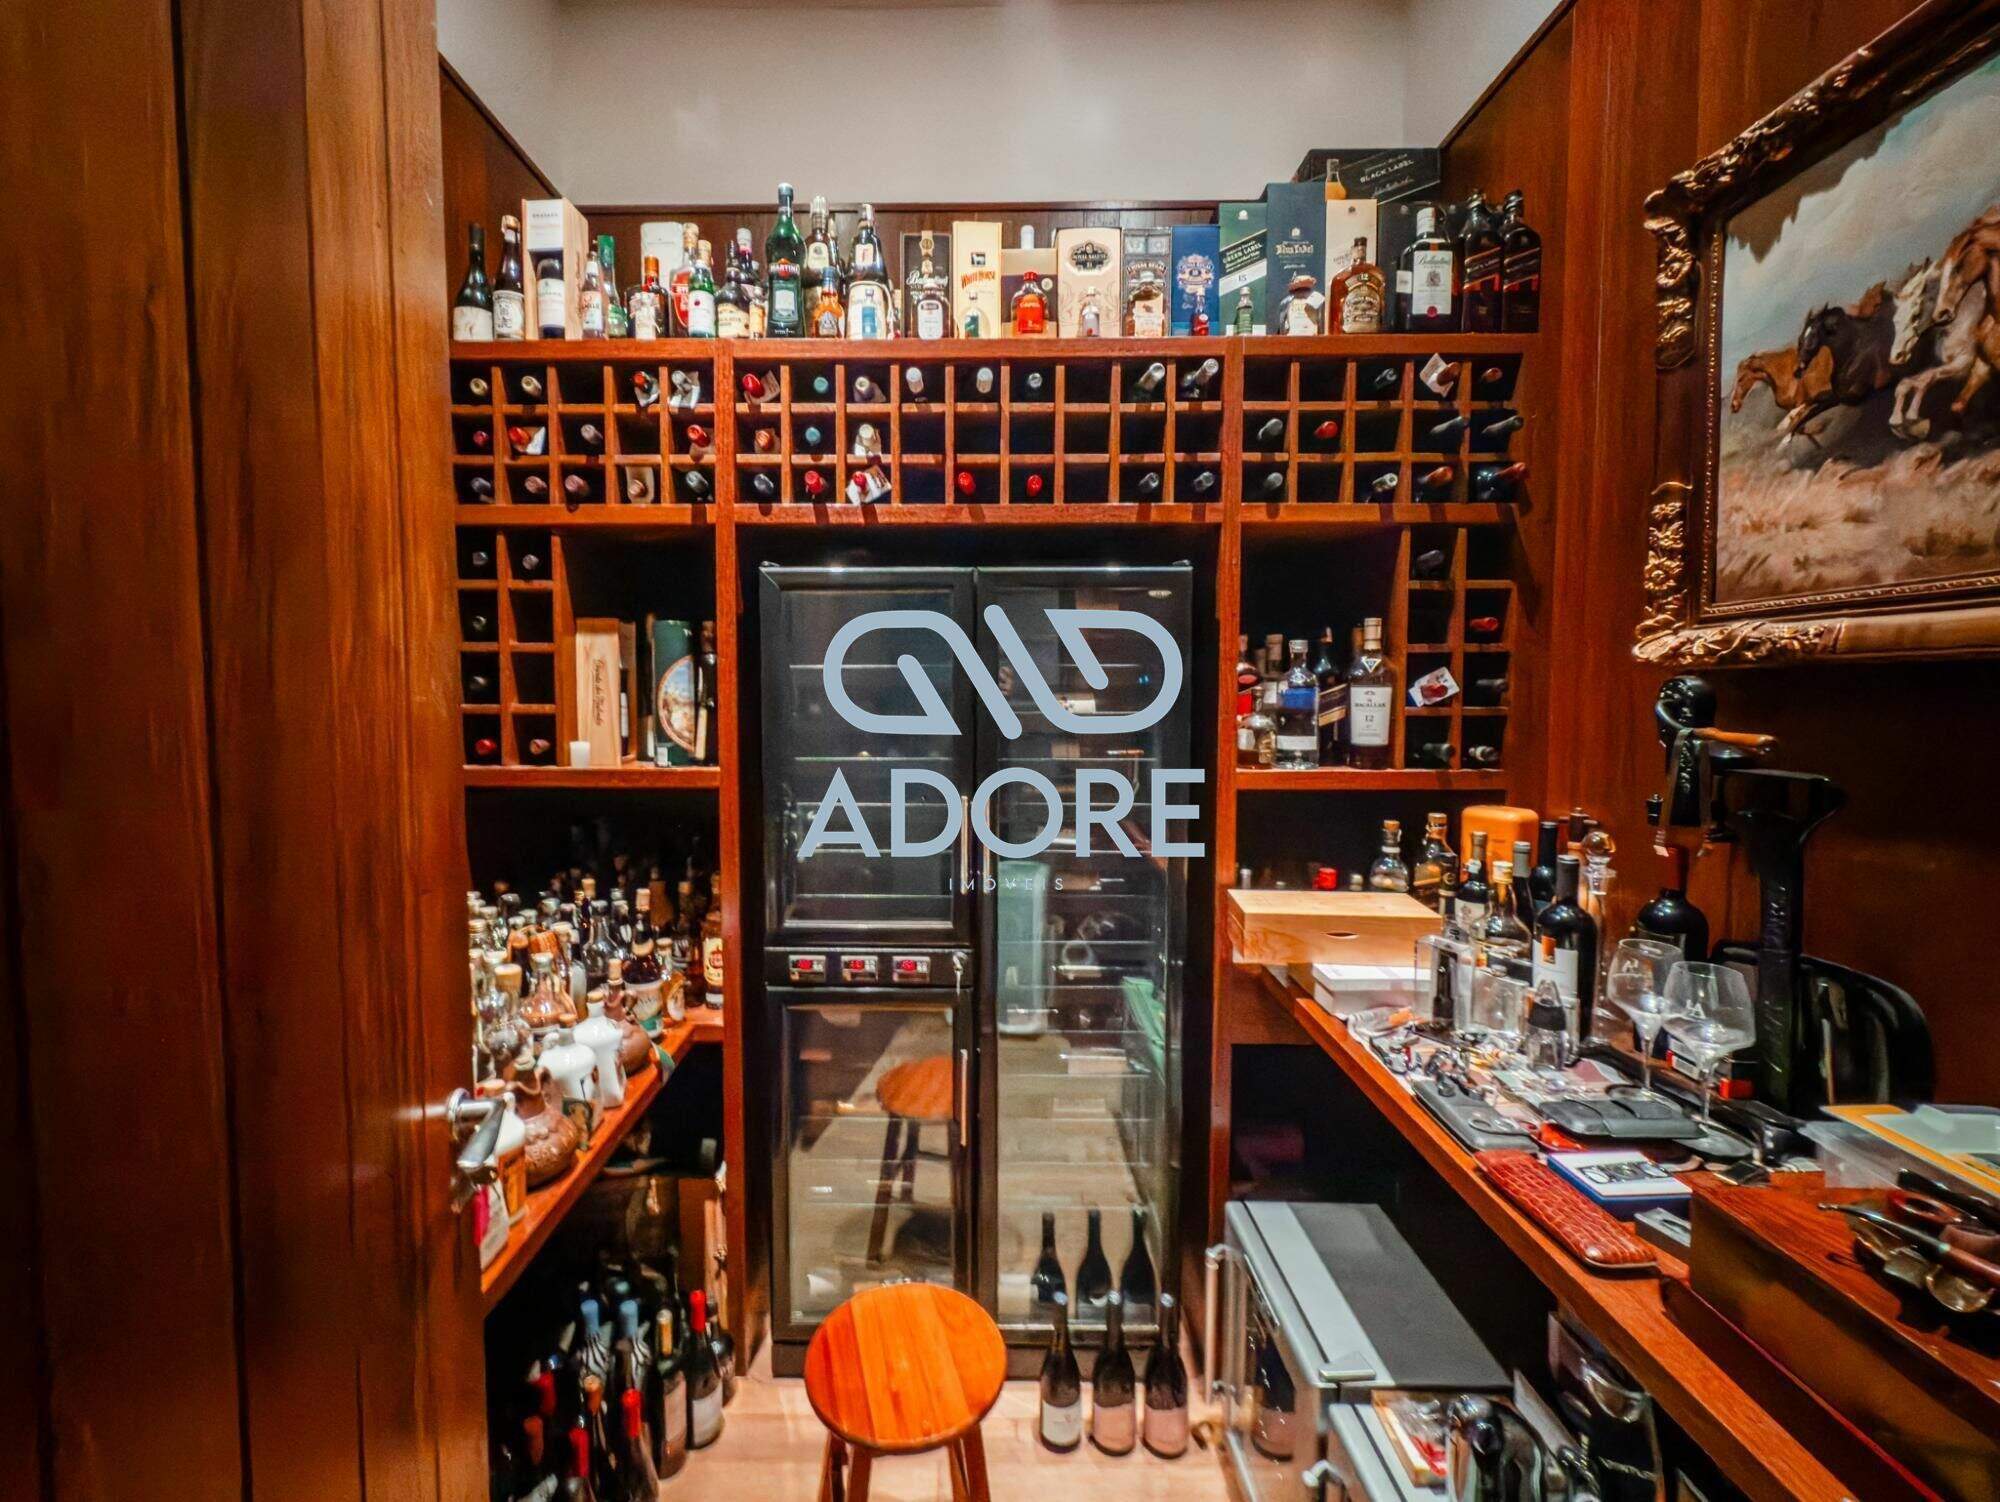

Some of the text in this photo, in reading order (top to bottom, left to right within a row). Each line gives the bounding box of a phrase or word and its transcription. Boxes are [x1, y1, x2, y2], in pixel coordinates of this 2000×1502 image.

[1360, 168, 1387, 184] BLACK
[1387, 159, 1415, 173] LABEL
[1243, 243, 1263, 255] LABEL
[769, 263, 800, 274] MARTINI
